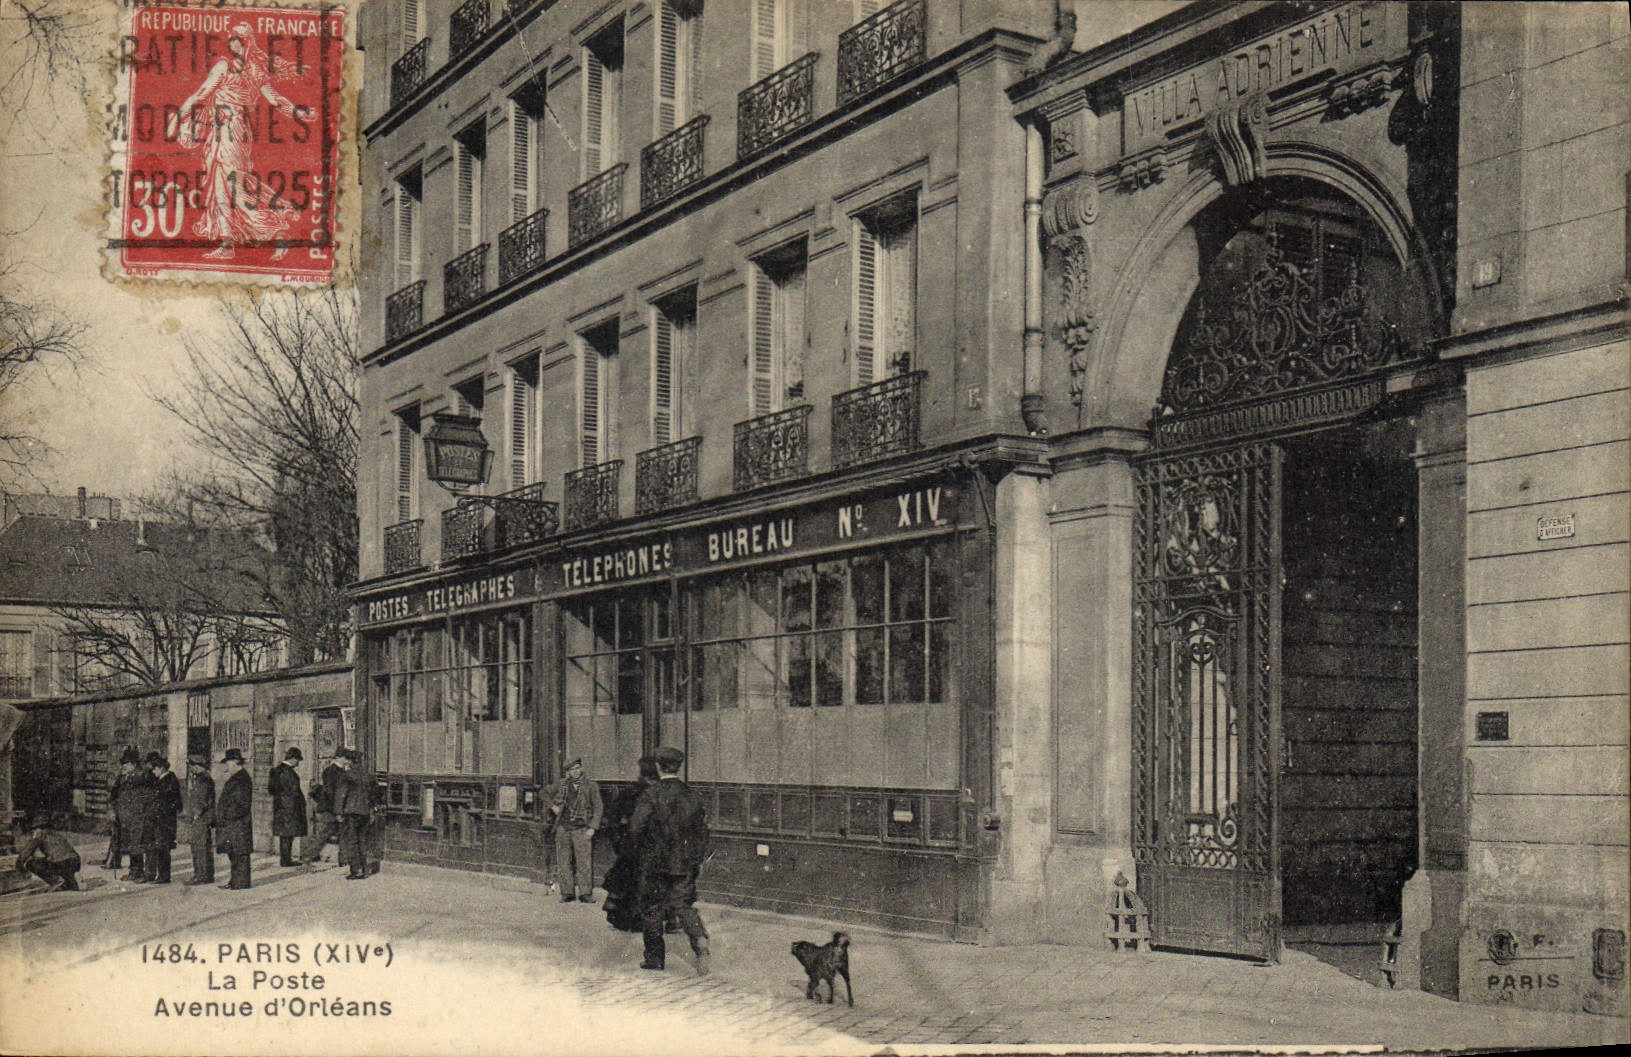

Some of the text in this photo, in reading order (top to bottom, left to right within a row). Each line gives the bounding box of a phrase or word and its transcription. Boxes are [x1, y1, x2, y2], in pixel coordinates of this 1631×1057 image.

[257, 17, 338, 37] FRANCAIE
[267, 35, 312, 75] ET
[1132, 5, 1374, 136] VILLA ADRIENNE
[226, 171, 310, 212] 1925
[368, 596, 409, 622] POSTES
[708, 518, 793, 562] BUREAU
